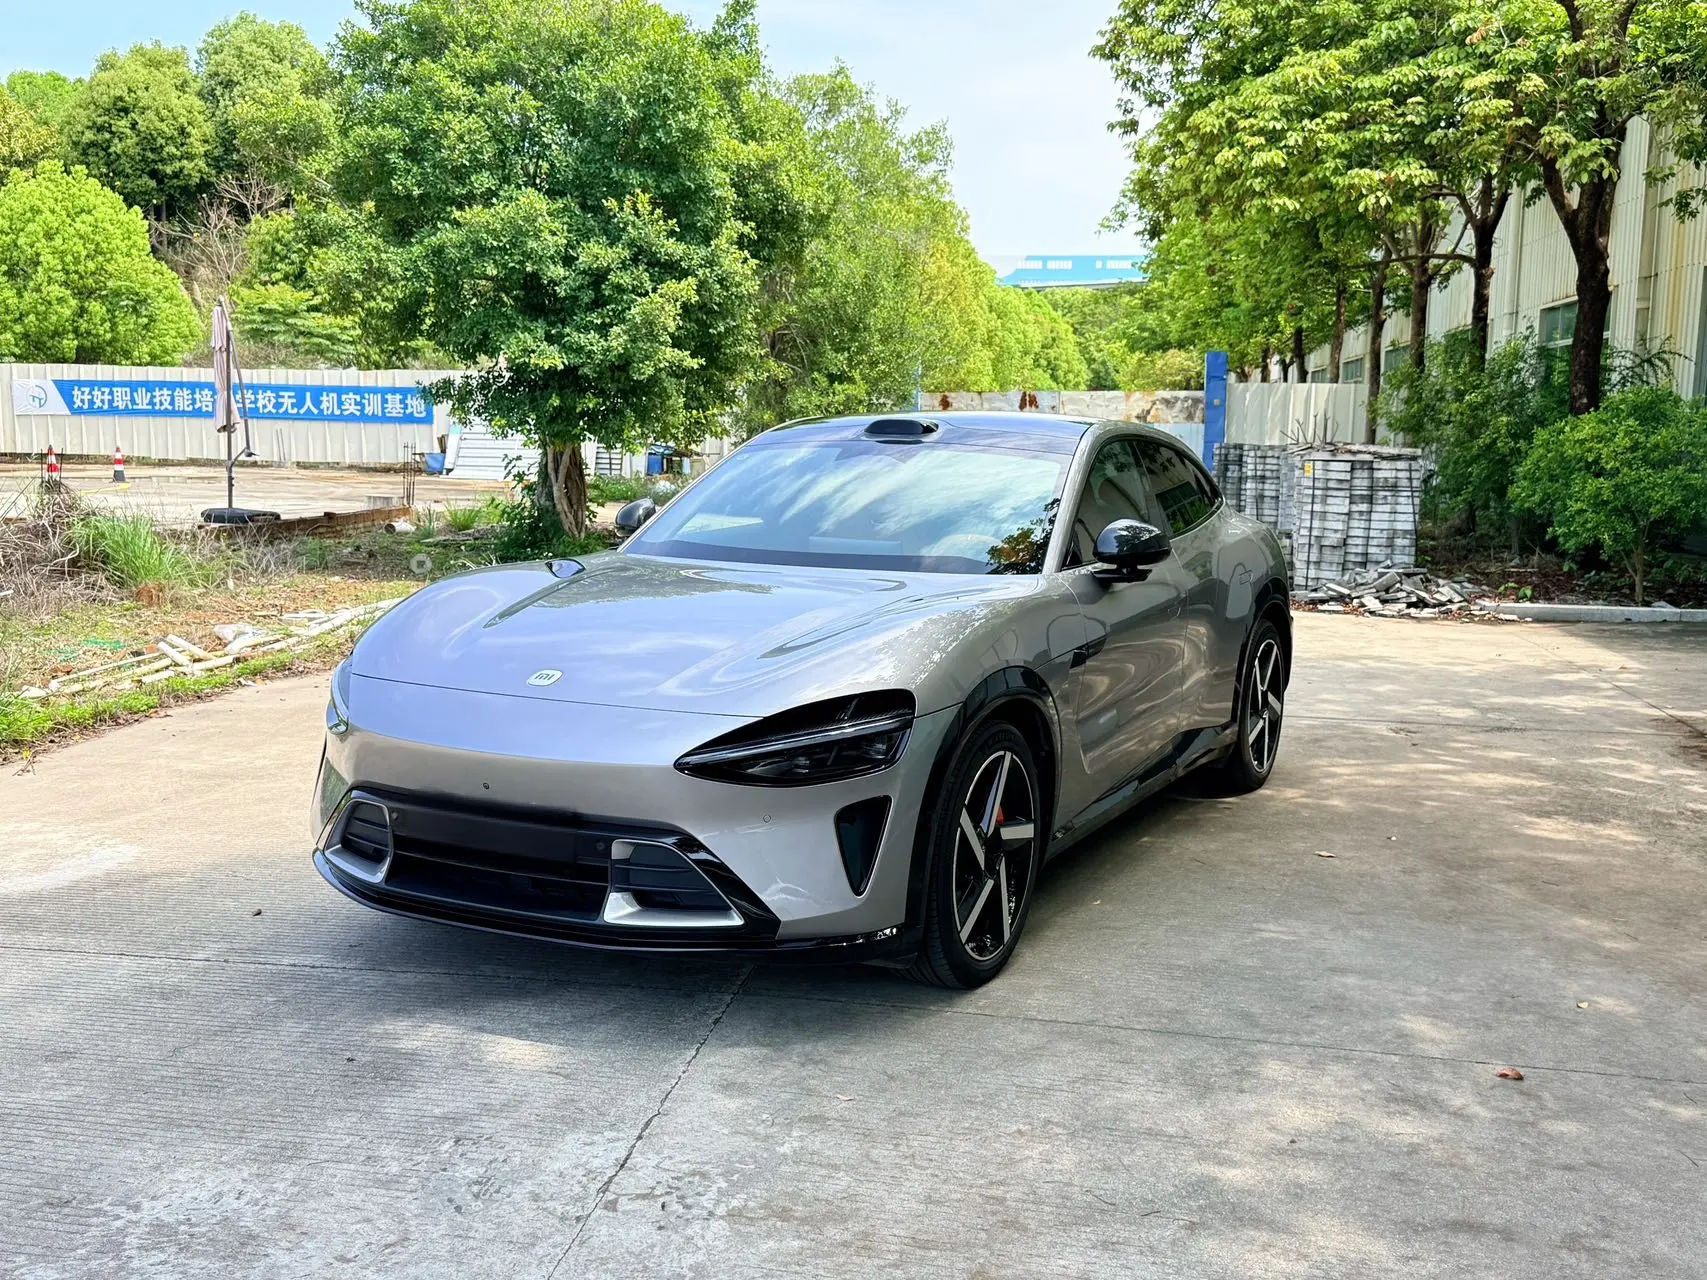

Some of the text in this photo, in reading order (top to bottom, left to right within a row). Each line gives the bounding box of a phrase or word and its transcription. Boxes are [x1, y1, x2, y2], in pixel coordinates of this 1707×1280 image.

[72, 386, 427, 418] 好好职业技能培学校无人机实训基地
